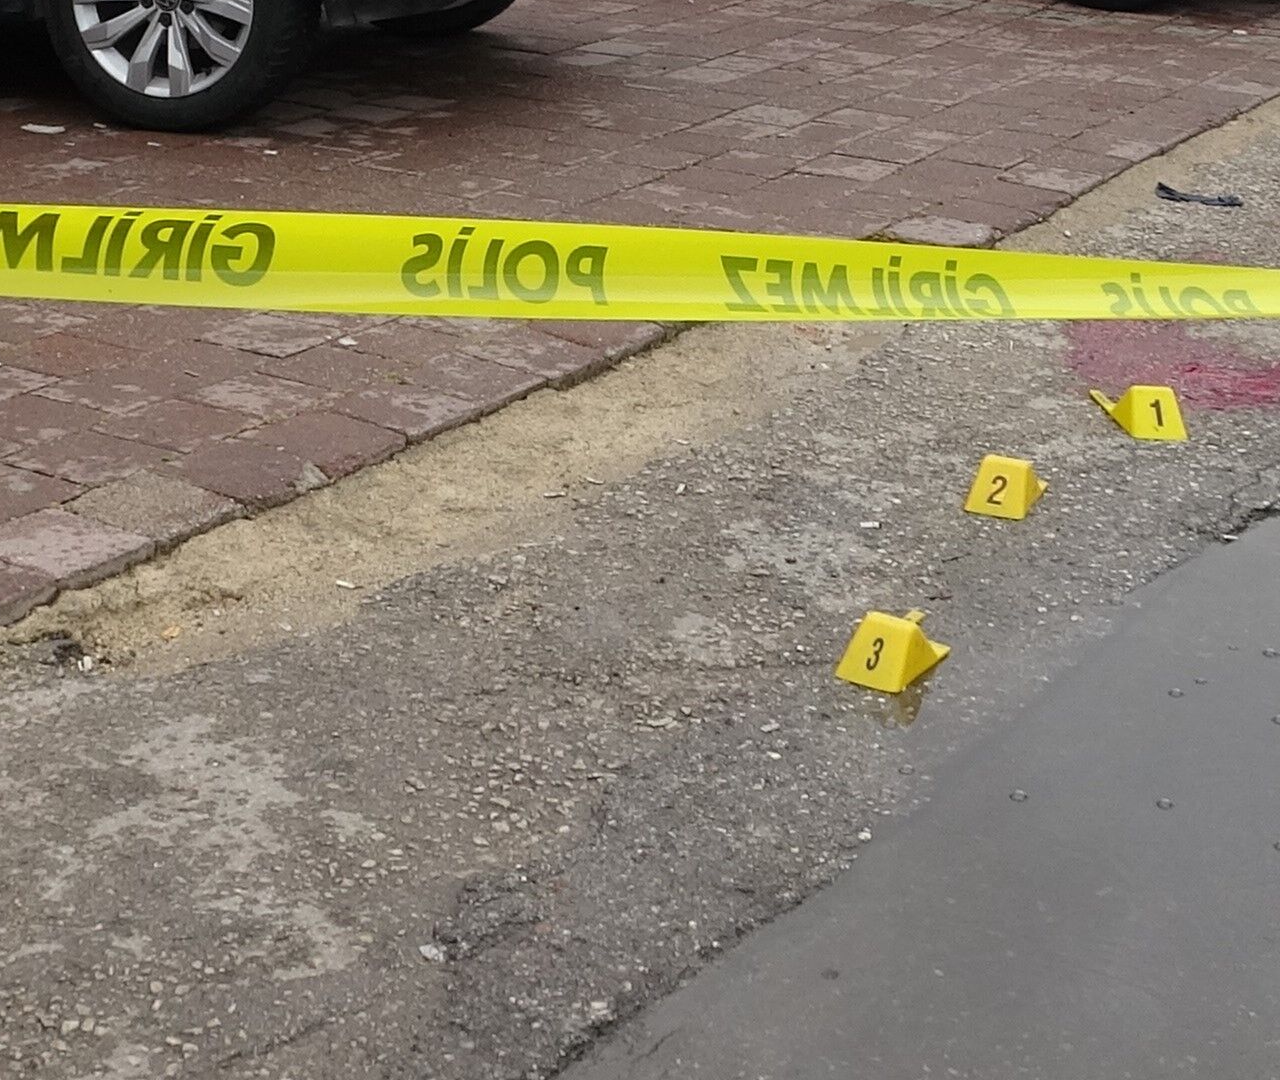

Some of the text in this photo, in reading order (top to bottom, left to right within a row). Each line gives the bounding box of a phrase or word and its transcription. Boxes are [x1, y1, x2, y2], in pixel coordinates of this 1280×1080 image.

[1148, 398, 1164, 428] 1
[985, 475, 1008, 506] 2
[865, 637, 885, 671] 3
